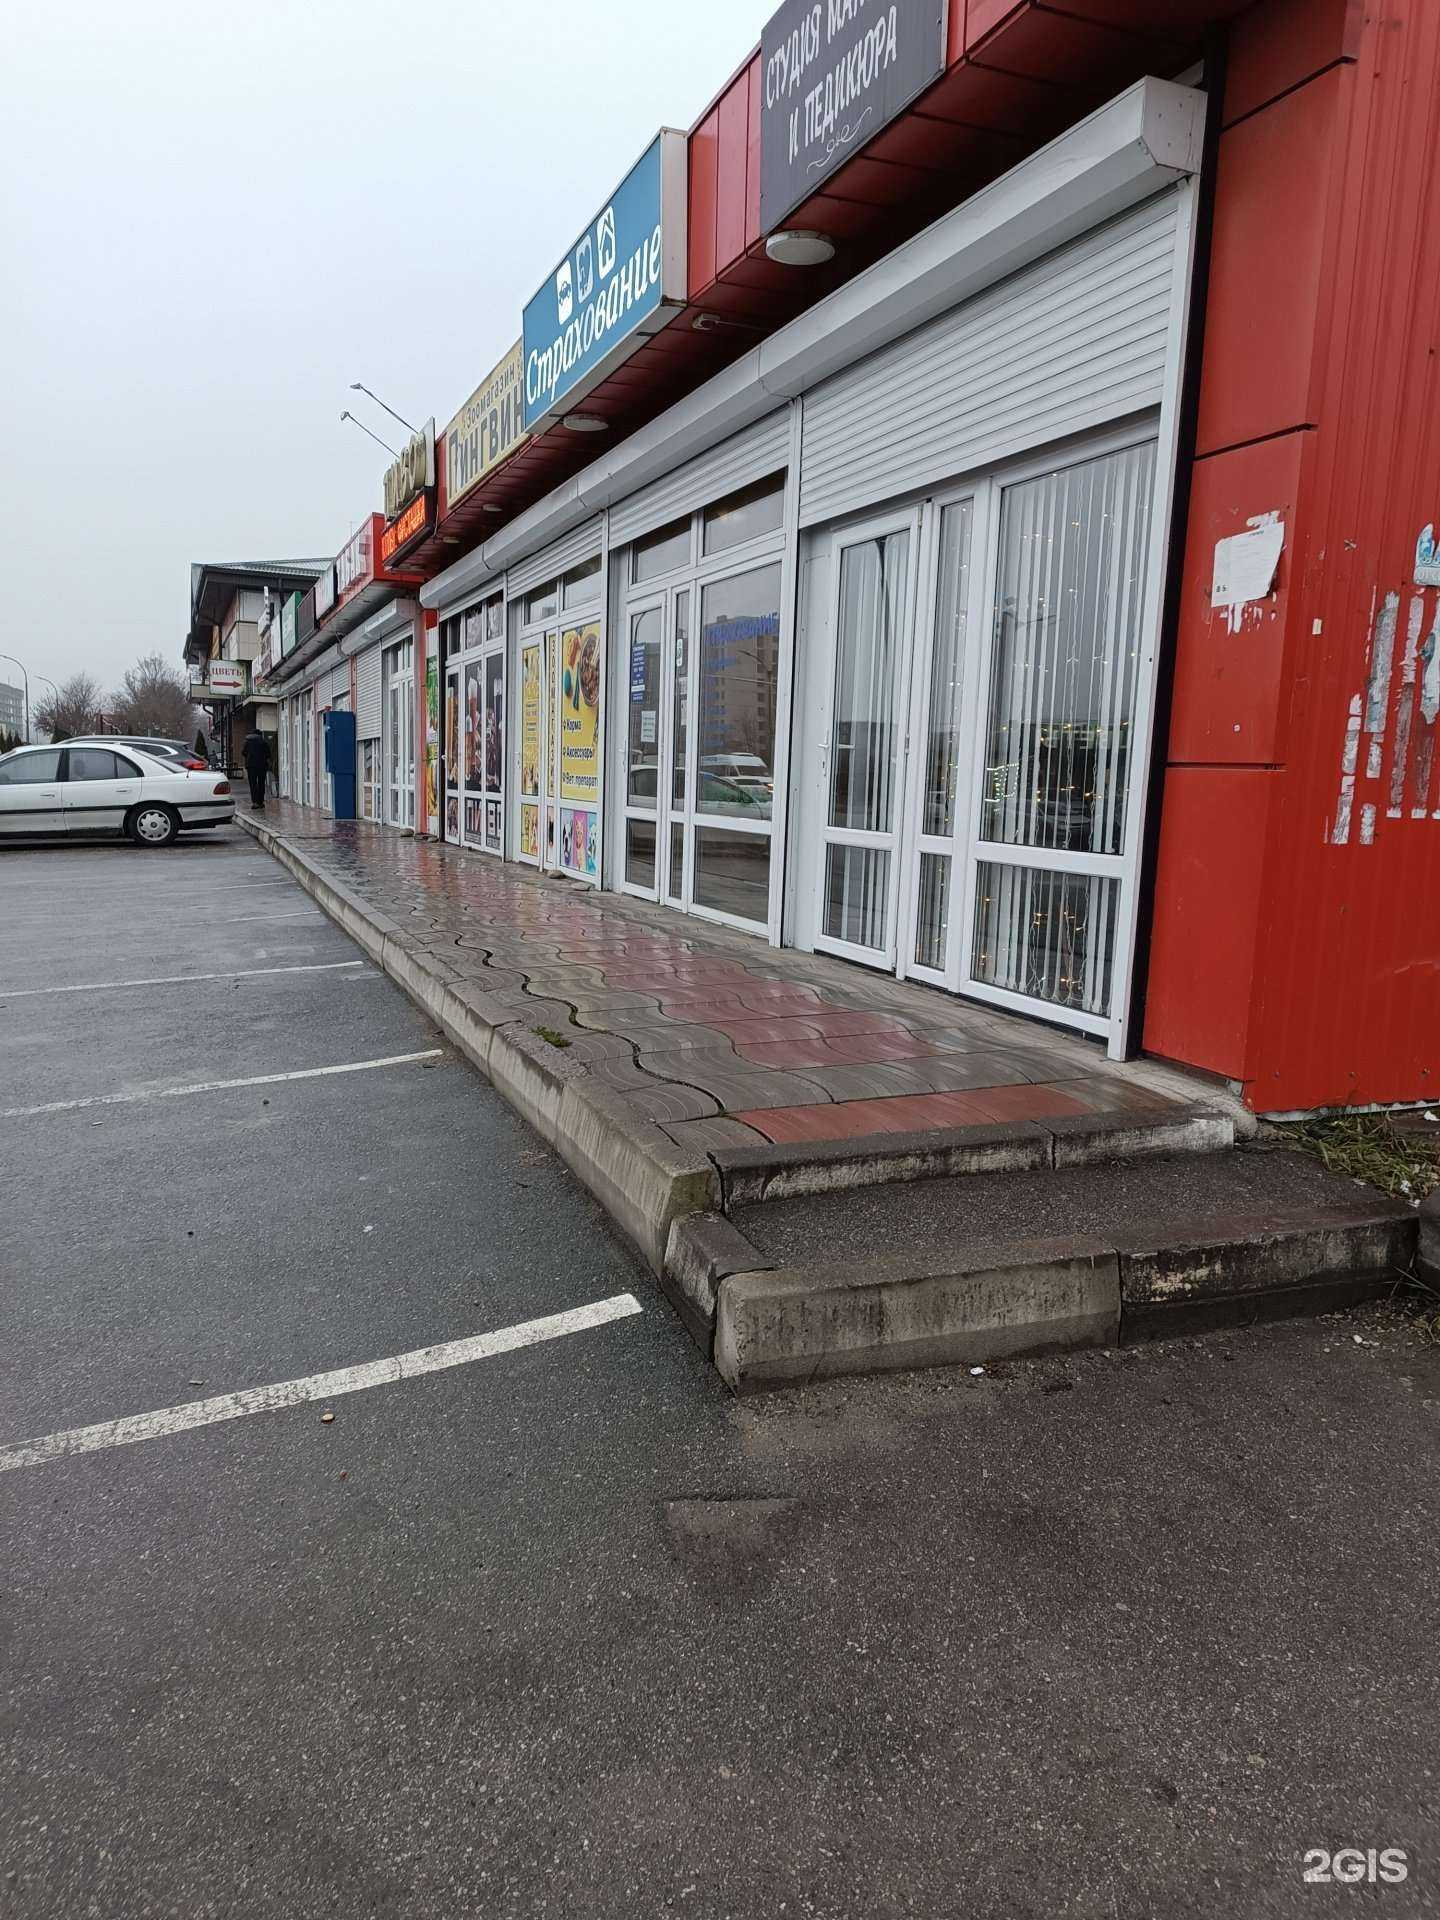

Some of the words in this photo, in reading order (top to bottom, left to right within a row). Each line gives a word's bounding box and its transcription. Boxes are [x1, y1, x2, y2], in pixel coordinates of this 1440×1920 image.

[766, 4, 821, 109] СТУДИЯ
[788, 106, 799, 166] И
[804, 5, 897, 148] ПЕДИКЮРА
[526, 224, 662, 406] Страхование
[449, 377, 525, 500] ПИНГВИН
[466, 362, 516, 429] Зоомагазин
